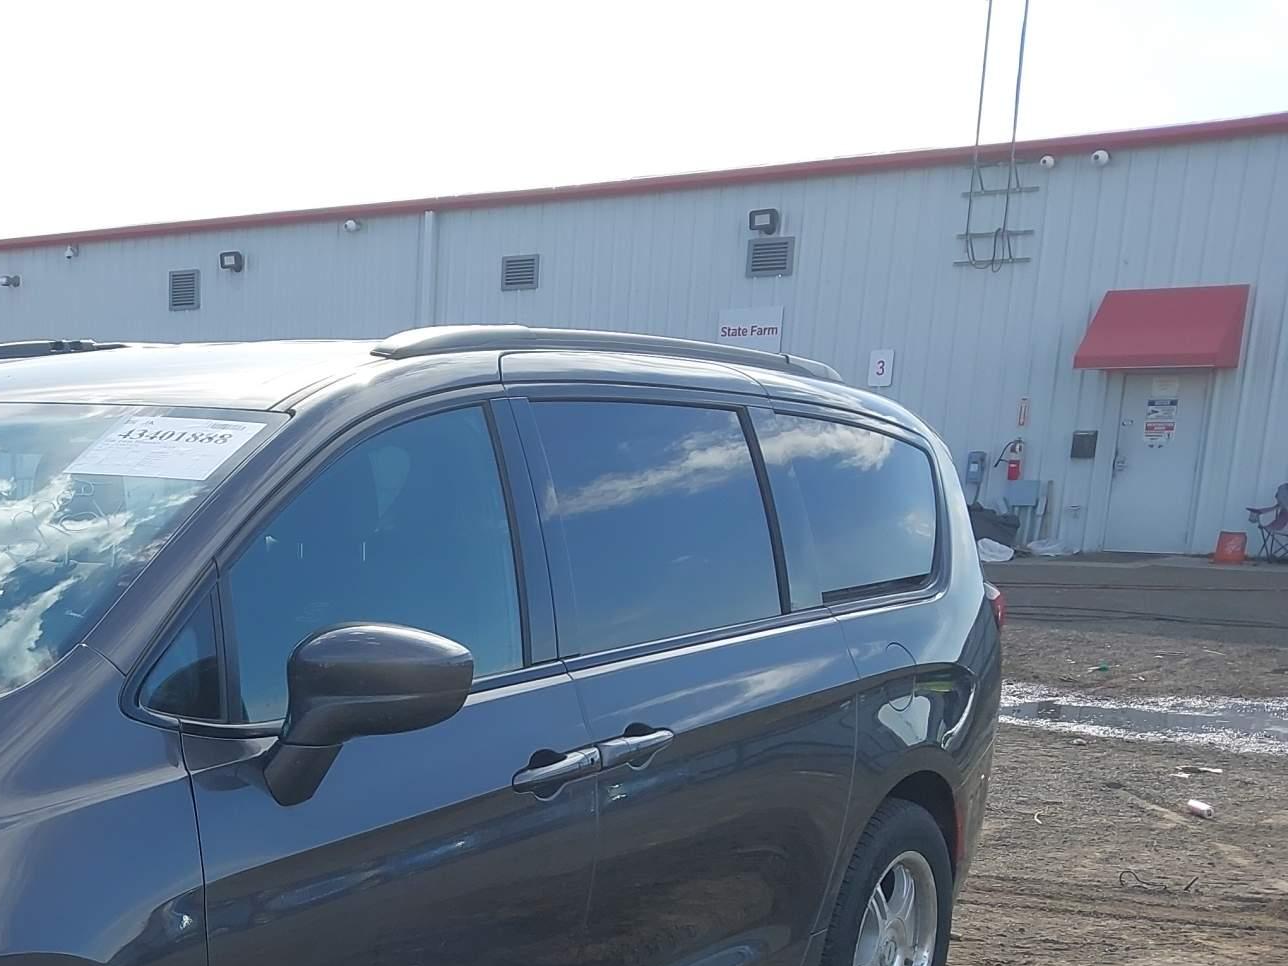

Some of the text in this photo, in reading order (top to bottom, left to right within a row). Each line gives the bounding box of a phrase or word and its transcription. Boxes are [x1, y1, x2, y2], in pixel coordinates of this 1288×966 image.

[720, 325, 778, 337] State Farm
[875, 360, 885, 376] 3
[118, 428, 233, 445] 43401888
